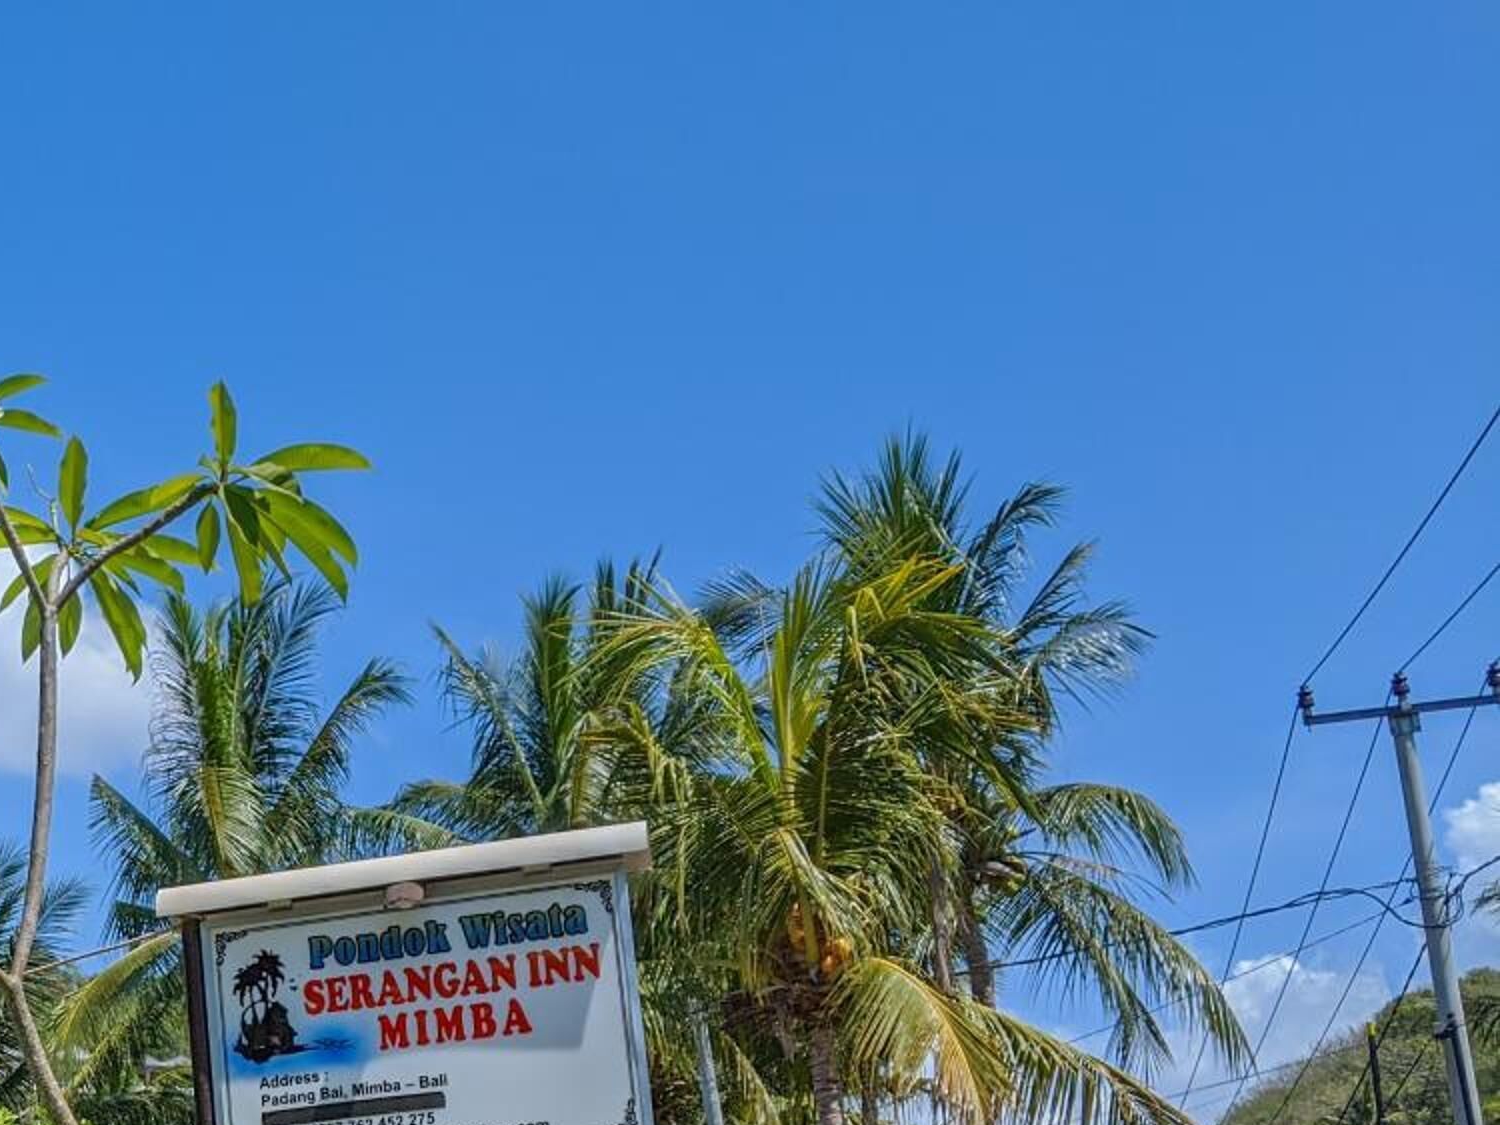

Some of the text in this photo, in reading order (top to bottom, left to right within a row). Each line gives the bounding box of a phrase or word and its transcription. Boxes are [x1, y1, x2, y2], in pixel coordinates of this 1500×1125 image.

[309, 902, 589, 969] Pondok Wisata
[303, 942, 601, 1016] SERANGAN INN
[378, 998, 533, 1050] MIMBA
[259, 1073, 320, 1090] Address
[261, 1089, 316, 1108] Padang
[352, 1080, 401, 1097] Mimba
[419, 1073, 448, 1089] Bali
